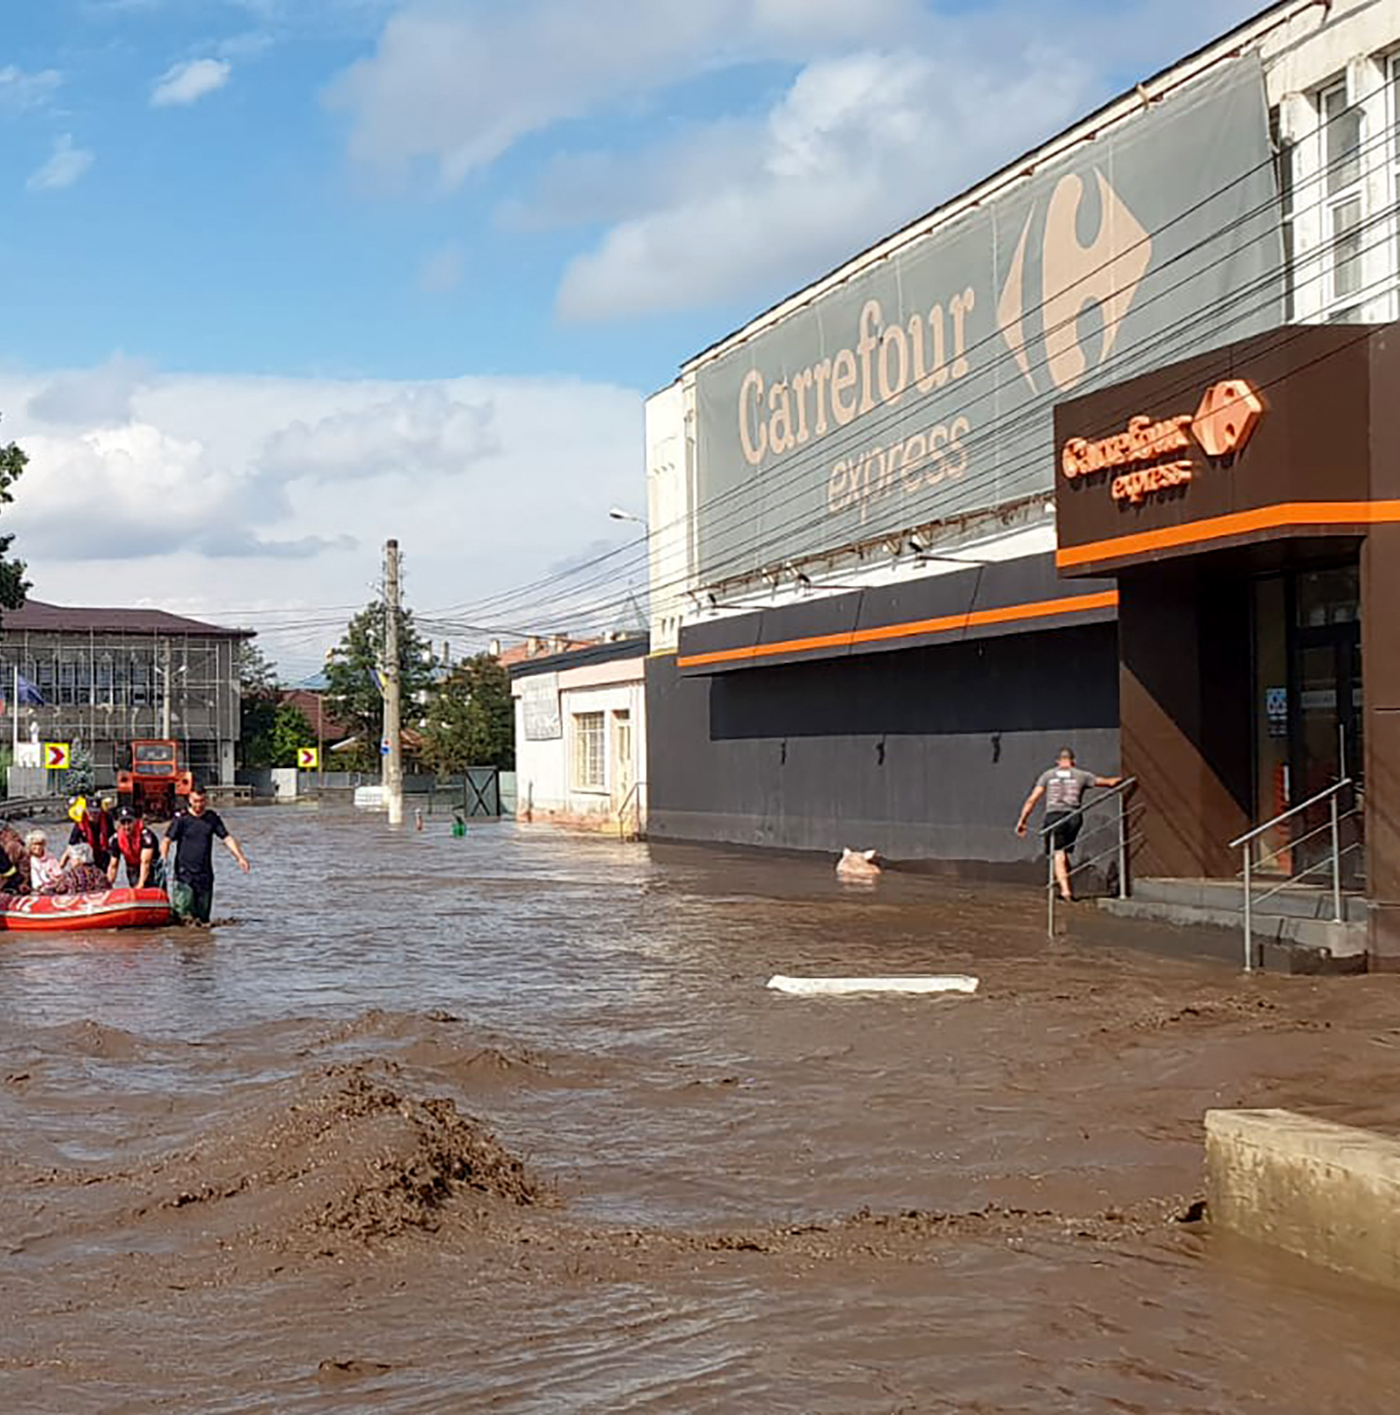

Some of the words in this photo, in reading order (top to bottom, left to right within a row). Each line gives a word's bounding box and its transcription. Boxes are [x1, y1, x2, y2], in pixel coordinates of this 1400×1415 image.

[738, 286, 975, 465] Carrefour
[827, 415, 971, 525] express
[1062, 414, 1193, 479] Carrefour
